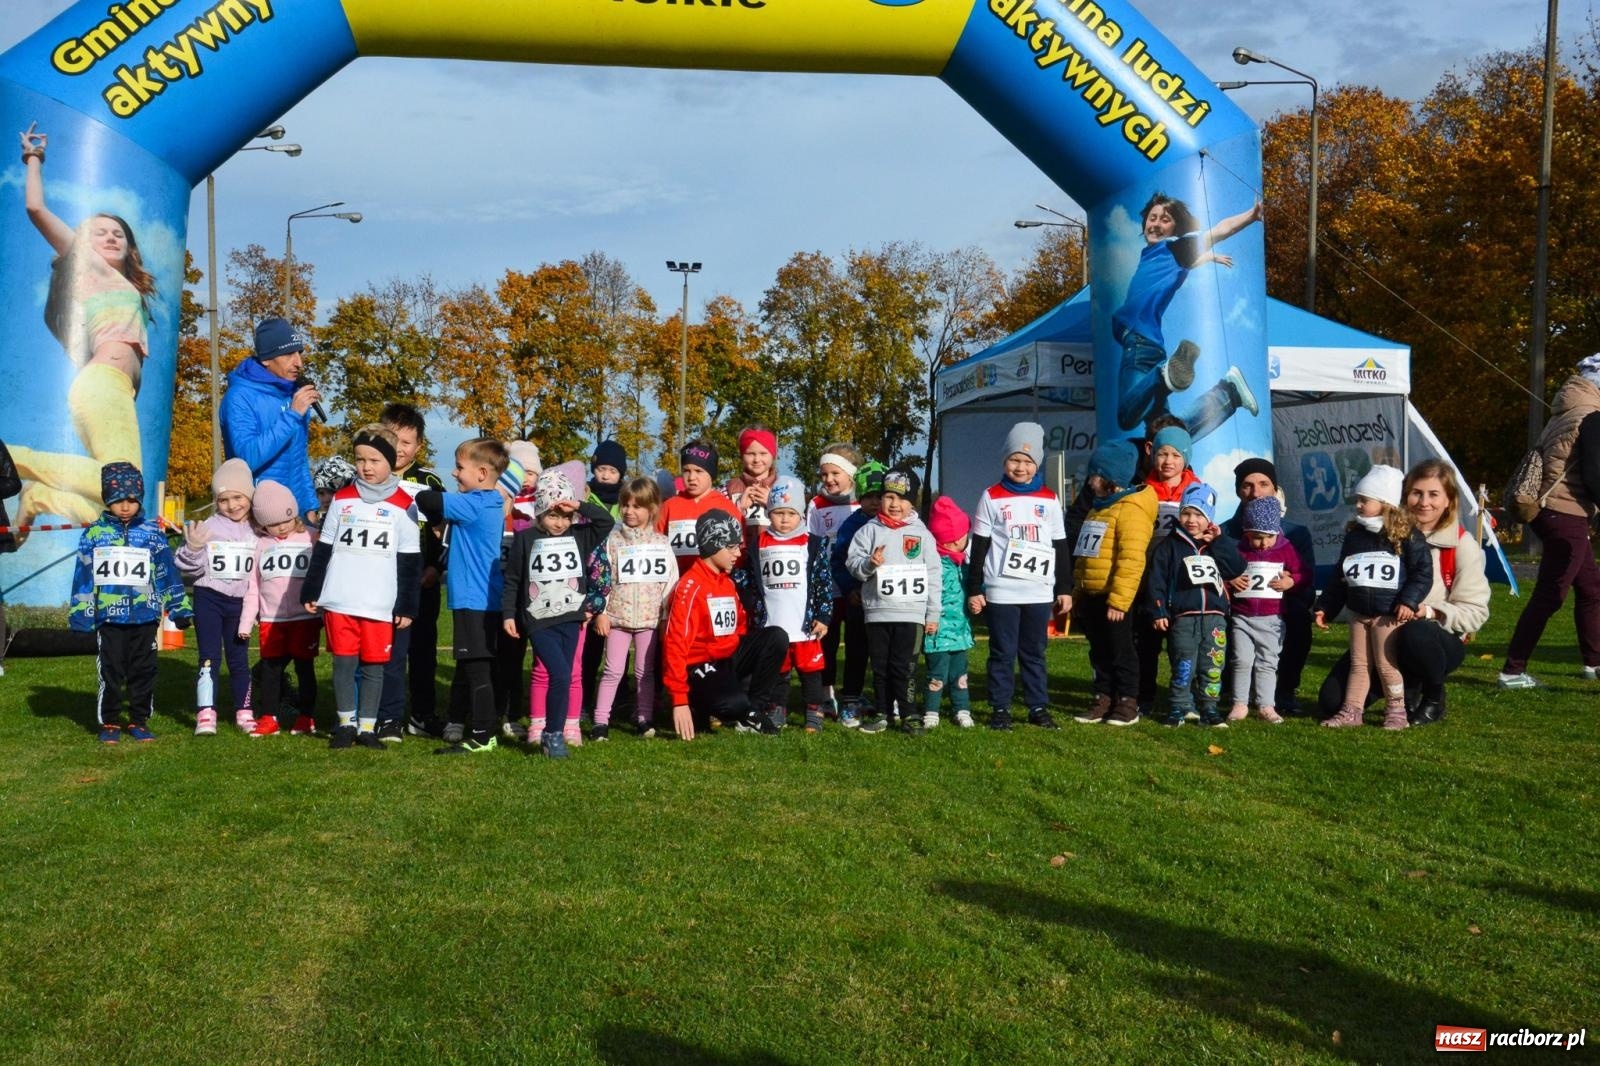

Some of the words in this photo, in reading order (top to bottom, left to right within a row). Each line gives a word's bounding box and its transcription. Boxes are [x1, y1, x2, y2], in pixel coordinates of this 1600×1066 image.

[988, 0, 1170, 162] aktywnych
[1121, 38, 1211, 128] ludzi
[1353, 369, 1387, 381] MITKO
[340, 528, 390, 549] 414
[670, 532, 698, 549] 40
[96, 560, 147, 579] 404
[212, 555, 253, 574] 510
[262, 554, 309, 571] 400
[531, 551, 578, 573] 433
[621, 558, 666, 575] 405
[762, 559, 801, 577] 409
[1008, 552, 1050, 576] 541
[1345, 563, 1395, 581] 419
[881, 577, 925, 596] 515
[714, 610, 736, 628] 469
[694, 662, 717, 679] 14
